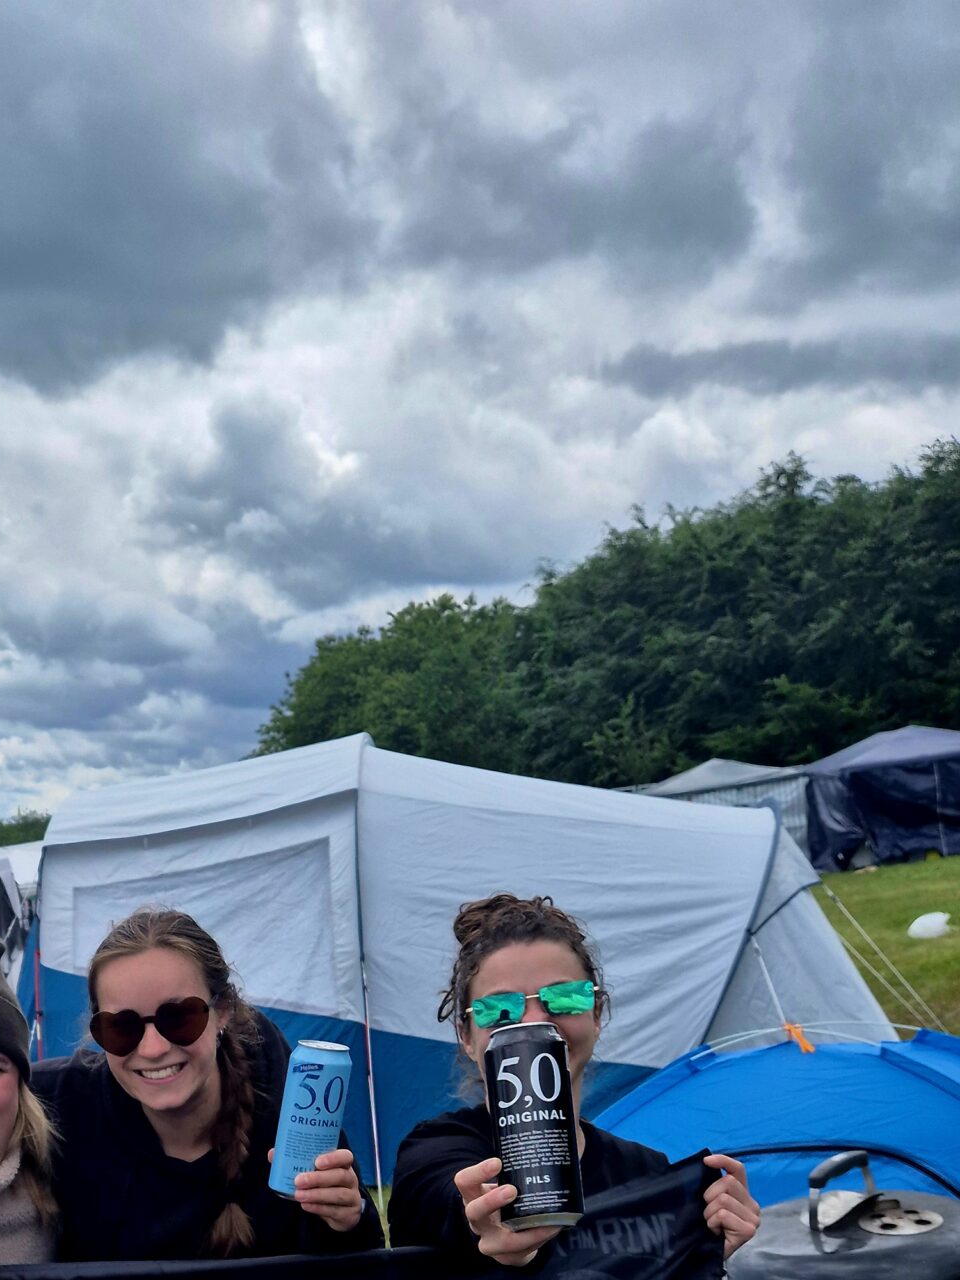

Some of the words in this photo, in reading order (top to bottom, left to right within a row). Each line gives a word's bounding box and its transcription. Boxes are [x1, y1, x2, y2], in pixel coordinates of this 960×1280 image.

[496, 1052, 562, 1109] 5,0
[294, 1073, 345, 1115] 5,0
[290, 1115, 339, 1128] ORIGINAL
[498, 1110, 567, 1127] ORIGINAL
[525, 1175, 551, 1185] PILS
